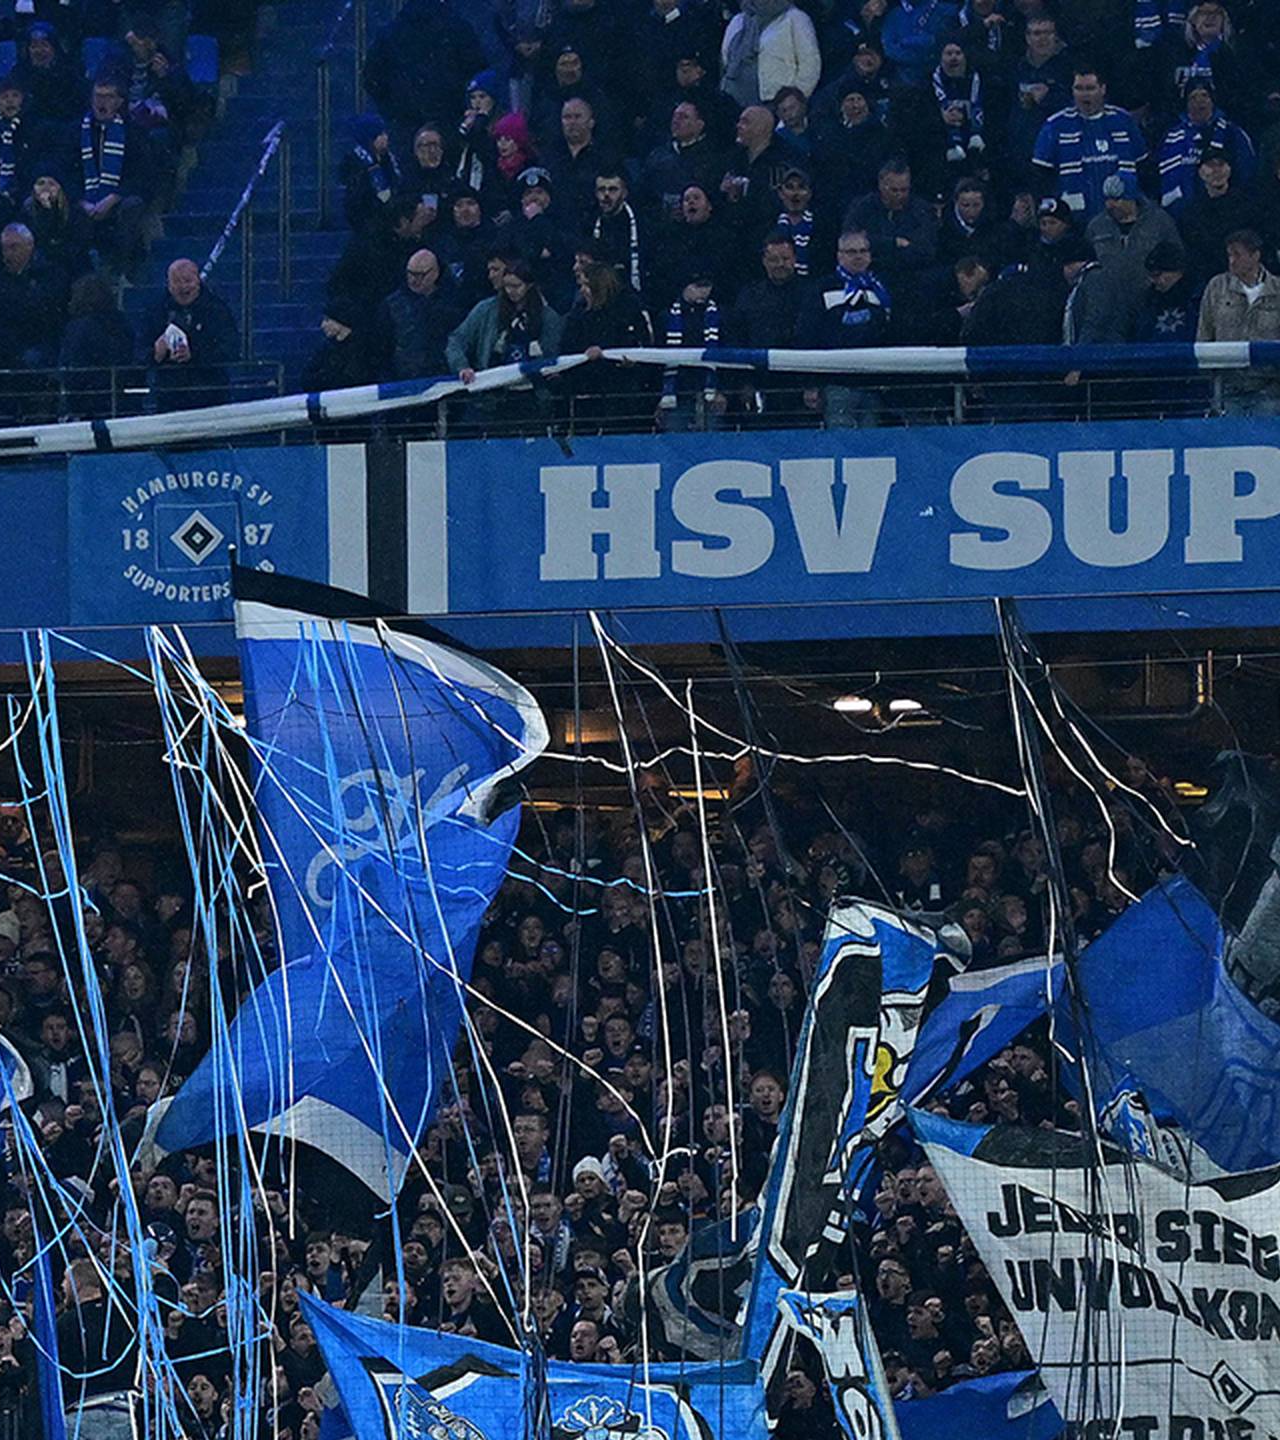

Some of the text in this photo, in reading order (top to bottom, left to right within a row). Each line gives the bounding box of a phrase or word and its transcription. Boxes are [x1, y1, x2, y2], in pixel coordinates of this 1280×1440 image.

[122, 471, 273, 514] HAMBURGER SV
[122, 524, 273, 550] 18 87
[540, 457, 897, 581] HSV
[123, 565, 231, 602] SUPPORTERS
